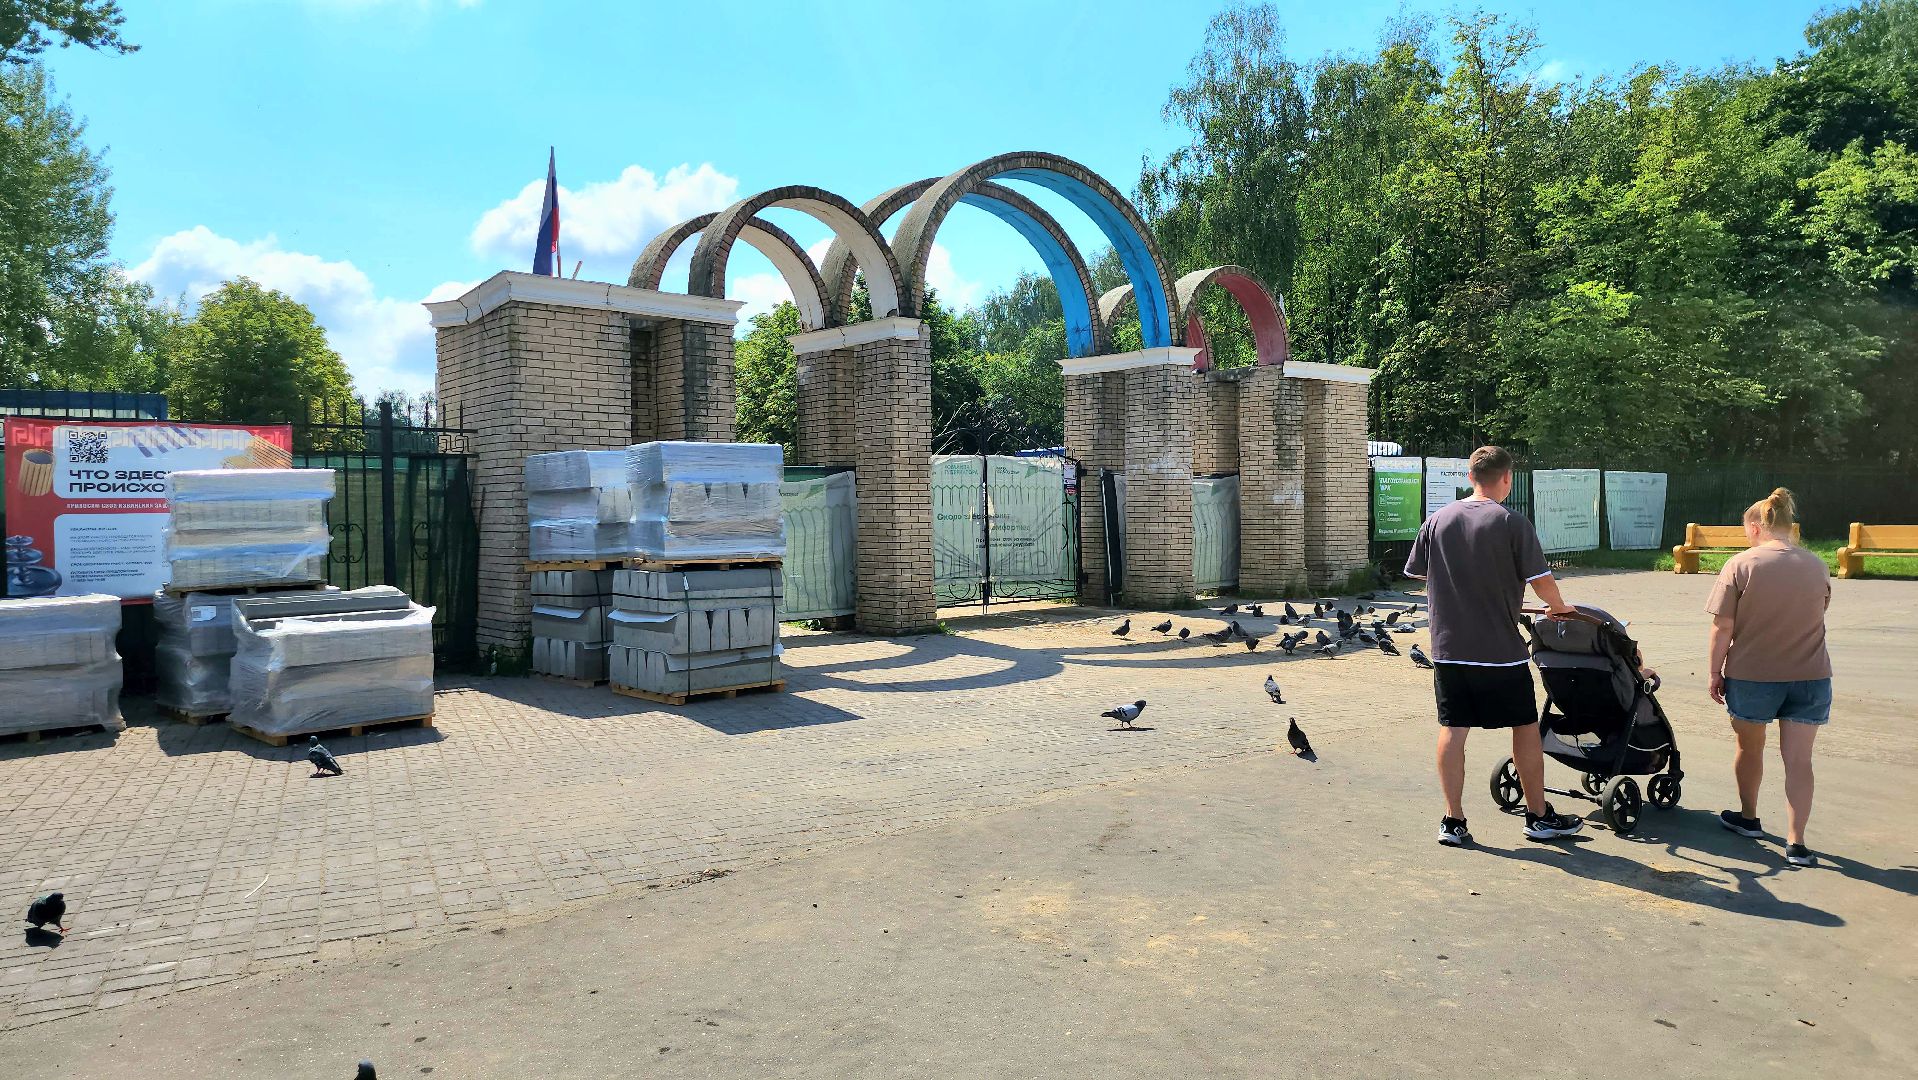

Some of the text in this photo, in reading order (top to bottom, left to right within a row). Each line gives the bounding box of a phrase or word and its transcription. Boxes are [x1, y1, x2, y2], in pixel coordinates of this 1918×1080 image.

[69, 469, 171, 482] ЧТО ЗДЕС
[69, 482, 166, 493] ПРОИСХО
